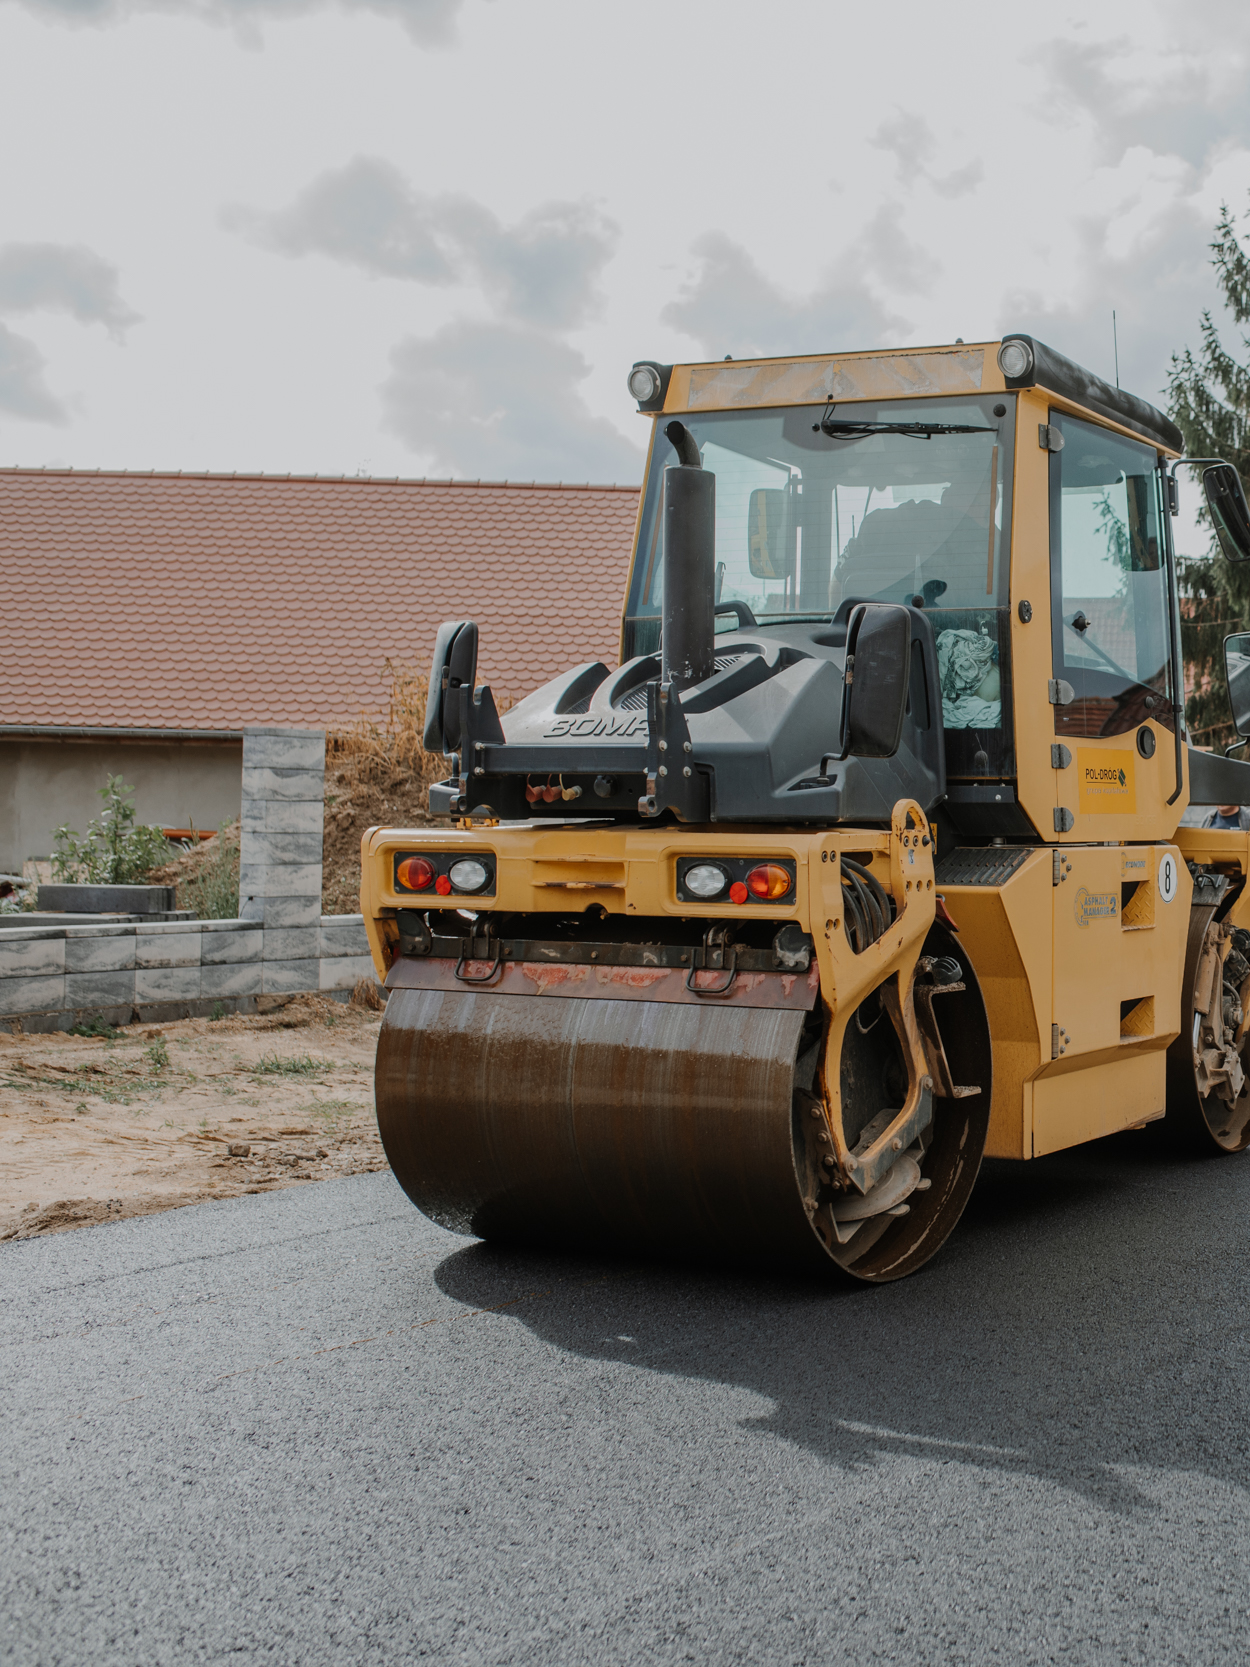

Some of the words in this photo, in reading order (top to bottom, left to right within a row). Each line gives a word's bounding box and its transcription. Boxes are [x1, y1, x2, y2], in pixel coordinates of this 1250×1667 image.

[542, 715, 650, 738] BOMA
[1165, 861, 1171, 894] 8
[1084, 896, 1108, 906] ASPHALT
[1109, 896, 1117, 914] 2
[1083, 906, 1109, 916] MANAGER
